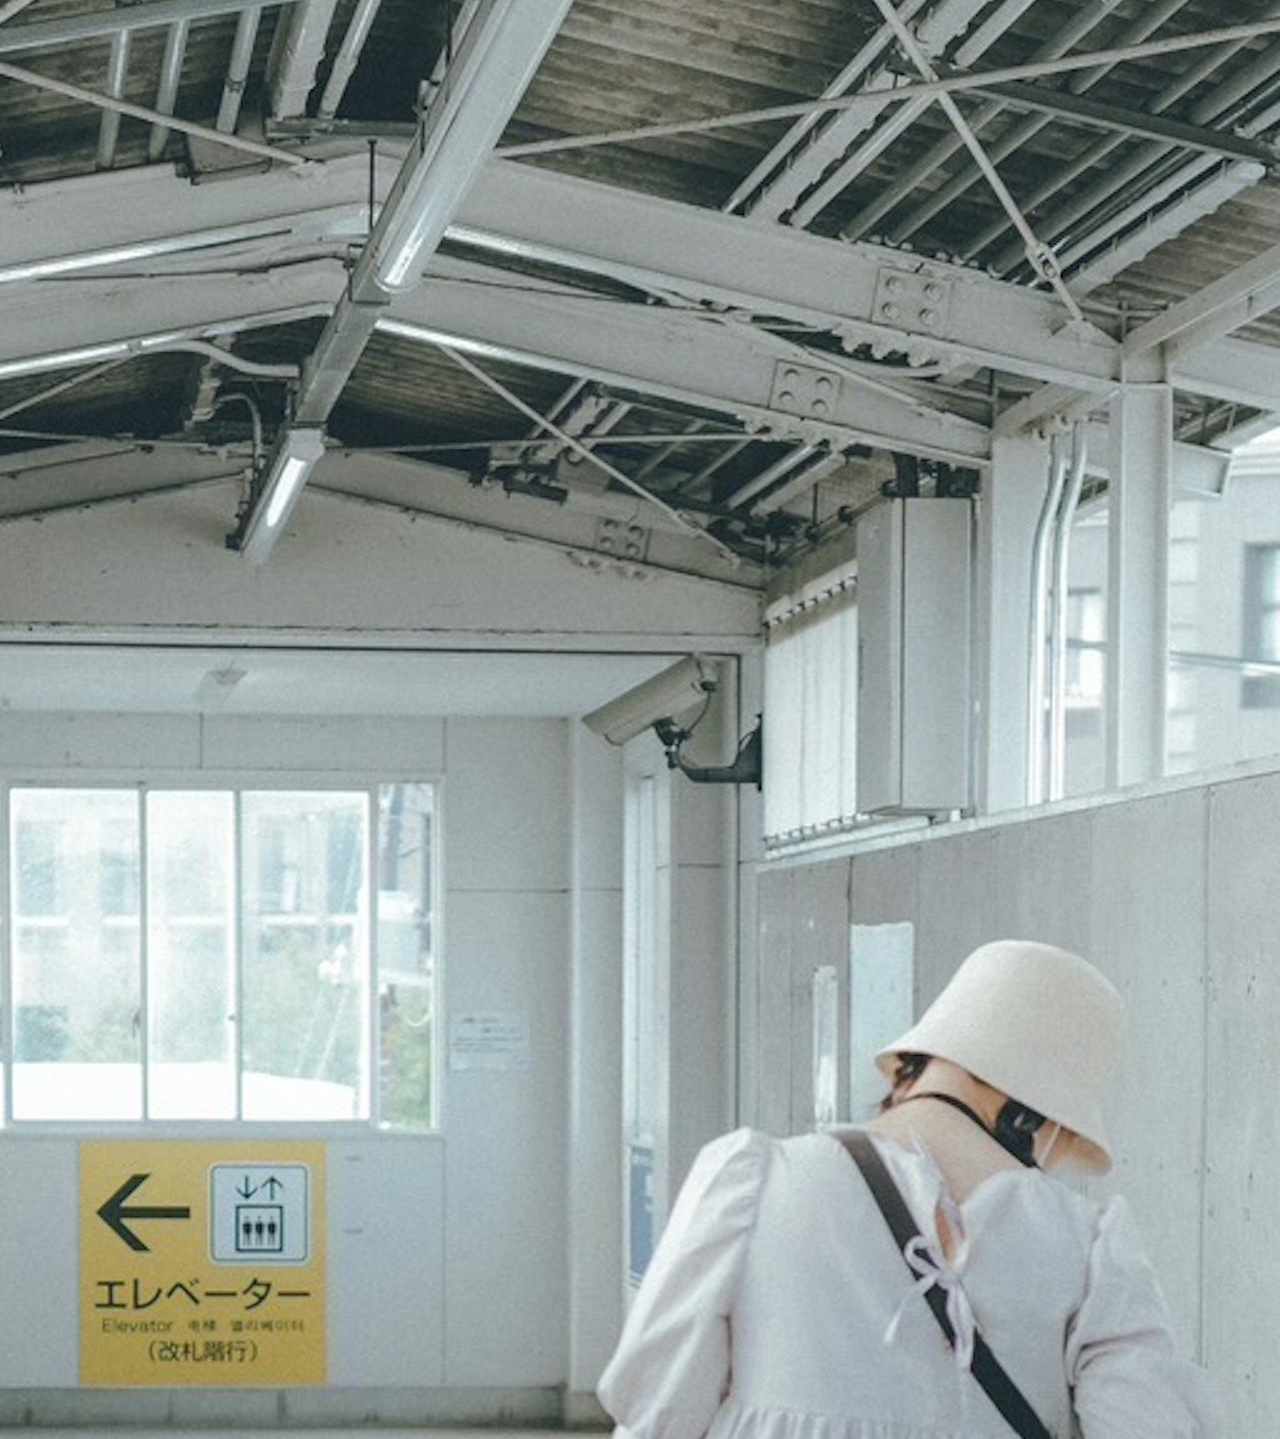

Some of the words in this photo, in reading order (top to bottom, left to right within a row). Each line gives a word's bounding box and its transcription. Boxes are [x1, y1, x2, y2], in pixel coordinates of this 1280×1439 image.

[95, 1278, 310, 1310] エレベーター
[102, 1318, 173, 1332] Elevator
